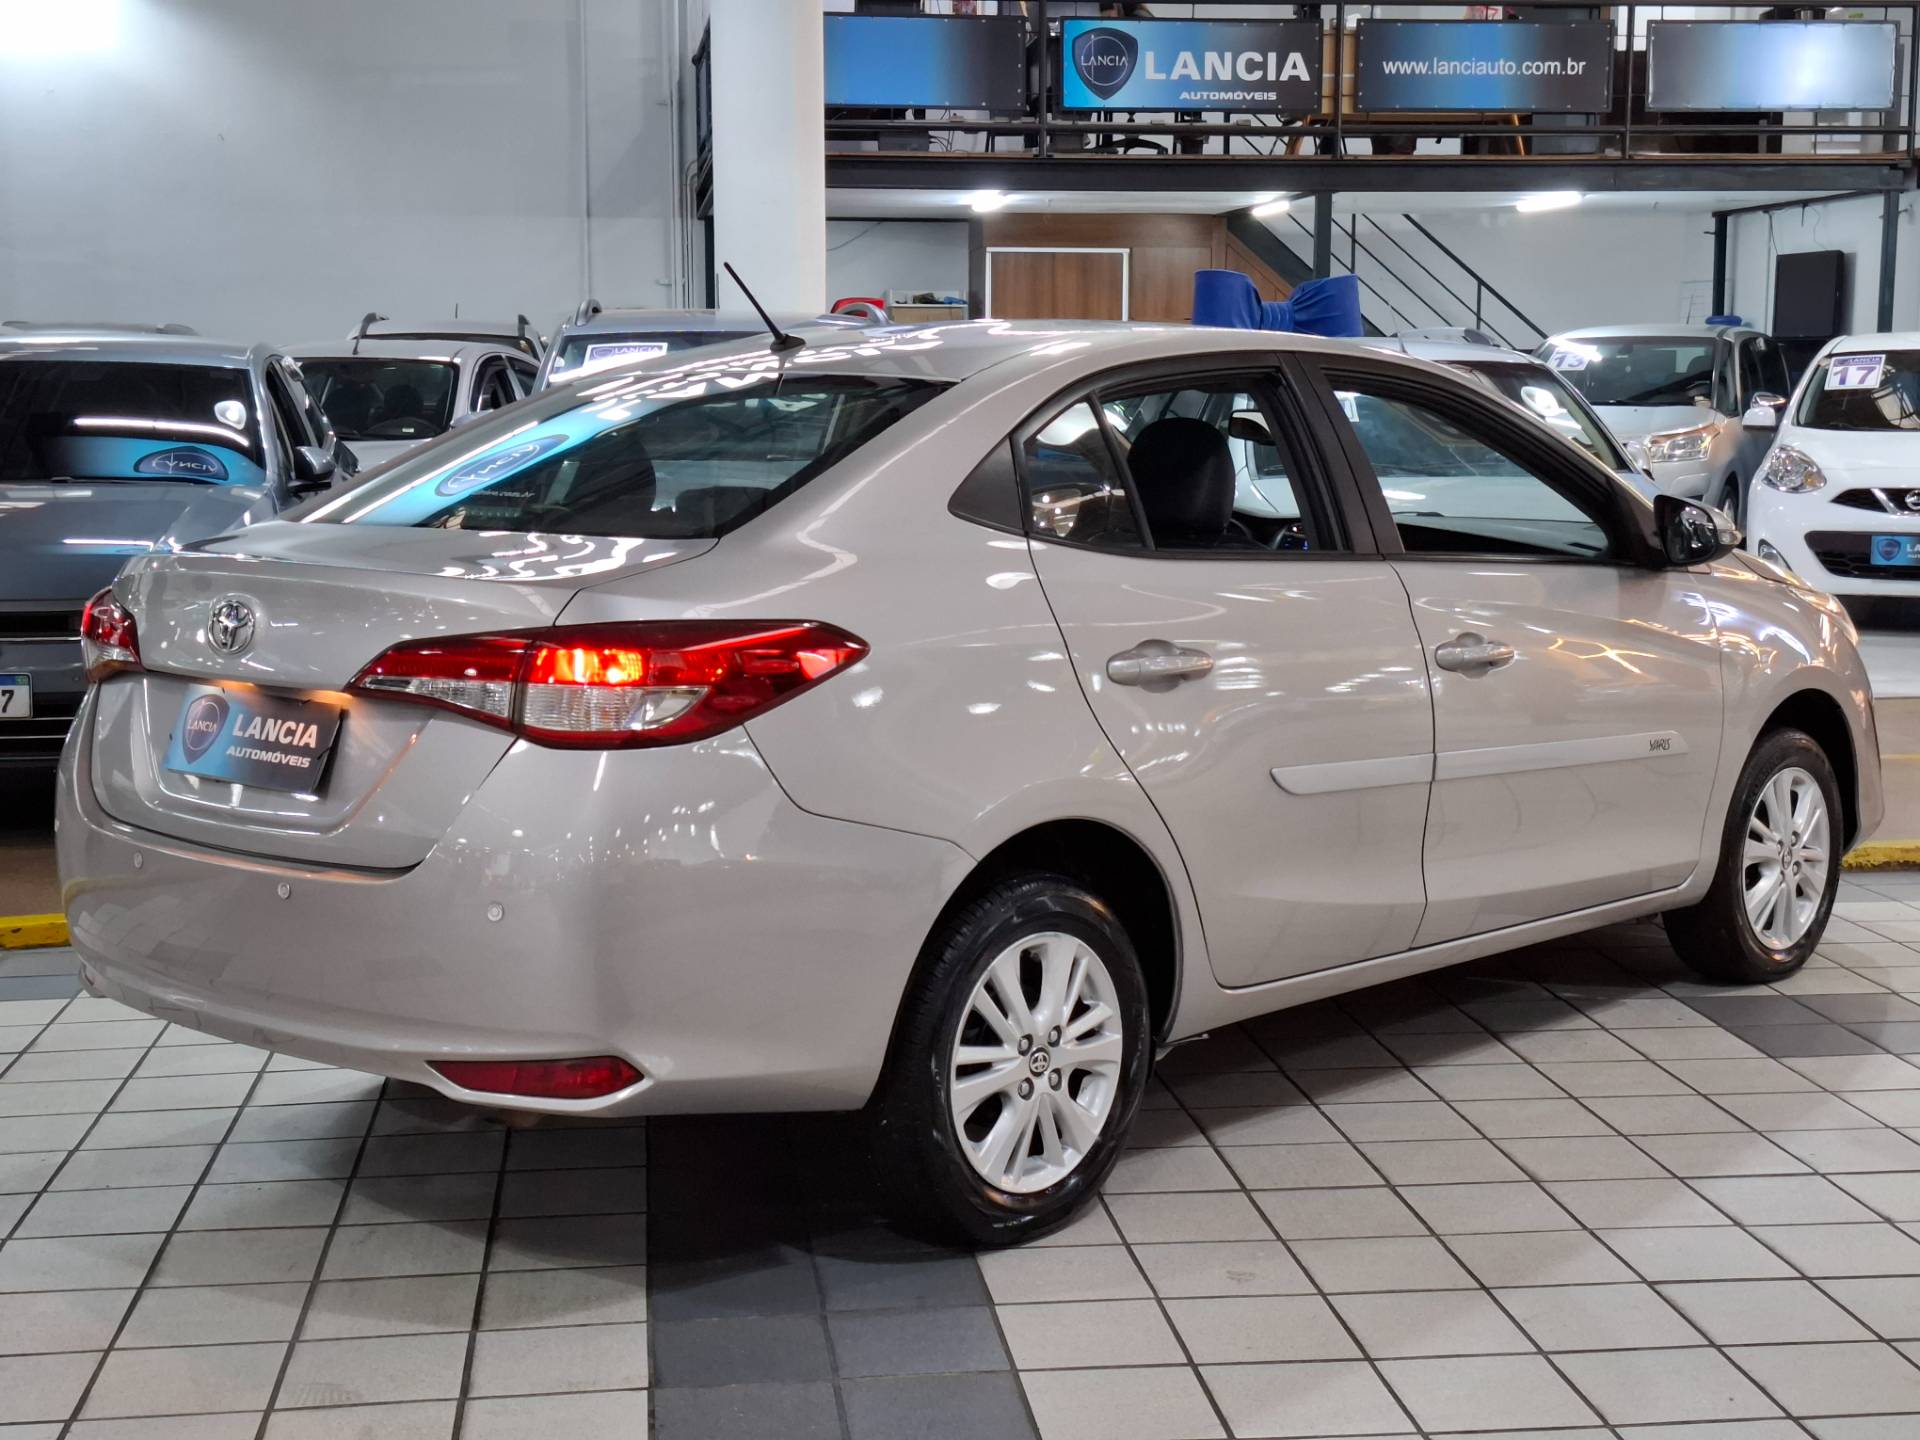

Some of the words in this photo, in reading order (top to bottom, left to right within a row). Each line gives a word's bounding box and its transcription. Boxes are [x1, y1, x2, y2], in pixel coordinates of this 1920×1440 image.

[1081, 56, 1128, 66] LANCIA
[1145, 51, 1311, 81] LANCIA
[1383, 57, 1586, 75] www.lanciauto.com.br
[1179, 91, 1277, 101] AUTOMÓVEIS
[1833, 366, 1877, 386] 17
[187, 720, 218, 733] LANCIA
[231, 714, 319, 748] LANCIA
[226, 745, 312, 768] AUTOMÓVEIS
